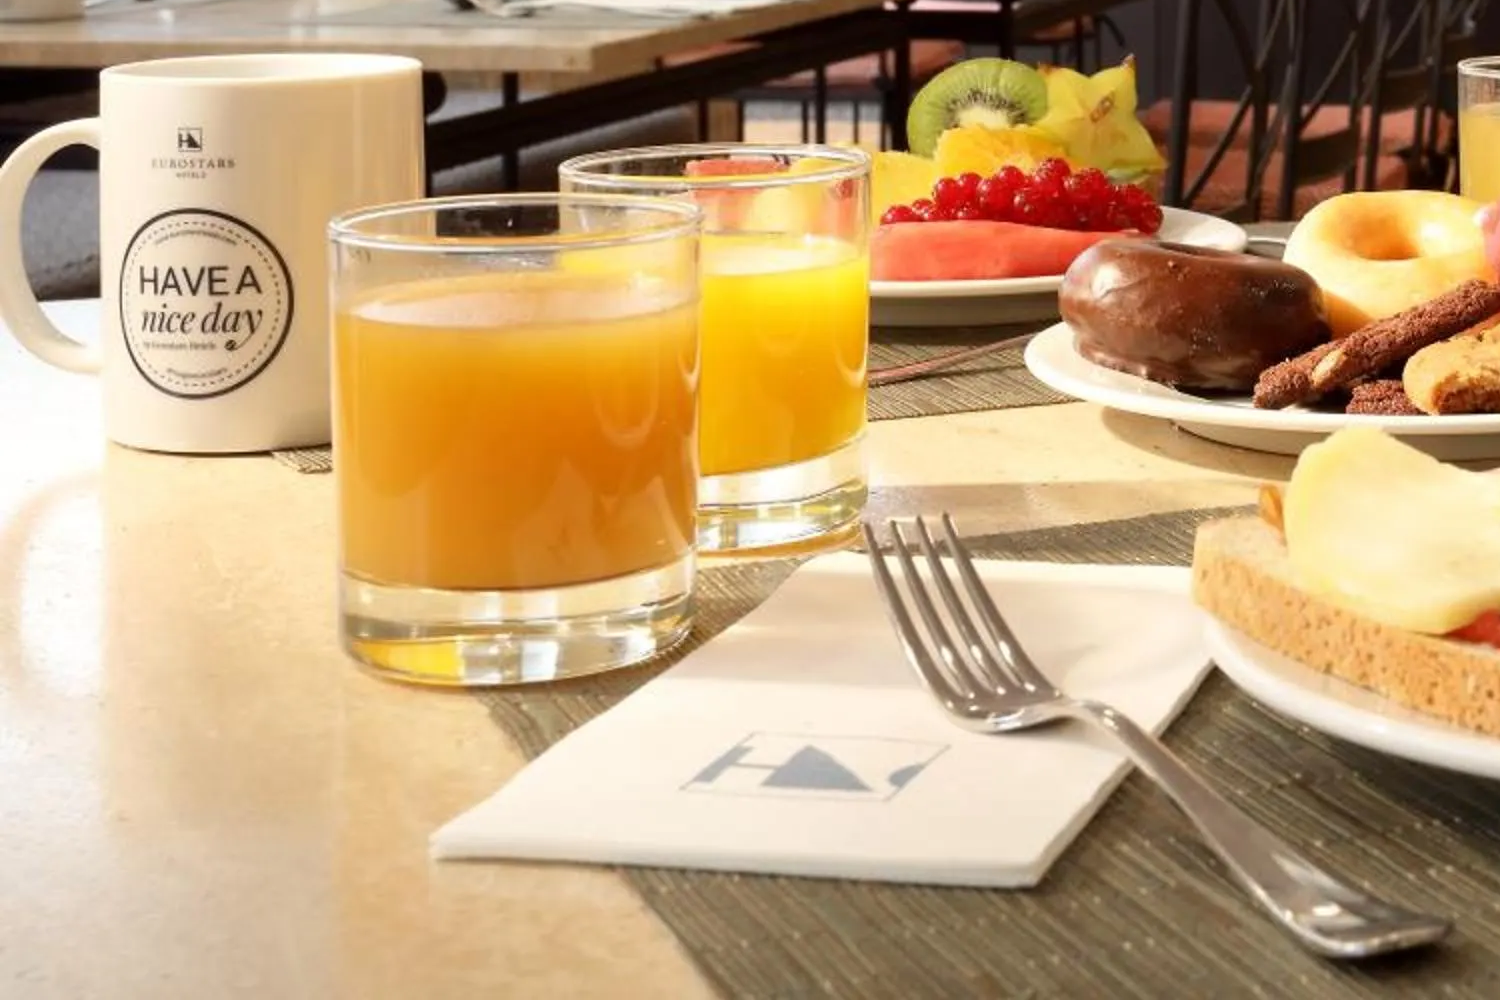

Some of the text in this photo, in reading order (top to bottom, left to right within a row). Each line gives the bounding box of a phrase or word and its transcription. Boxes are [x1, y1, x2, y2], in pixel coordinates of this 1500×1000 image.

[151, 158, 236, 169] EUROSTARS
[139, 265, 263, 296] HAVE A
[141, 301, 263, 351] nice day
